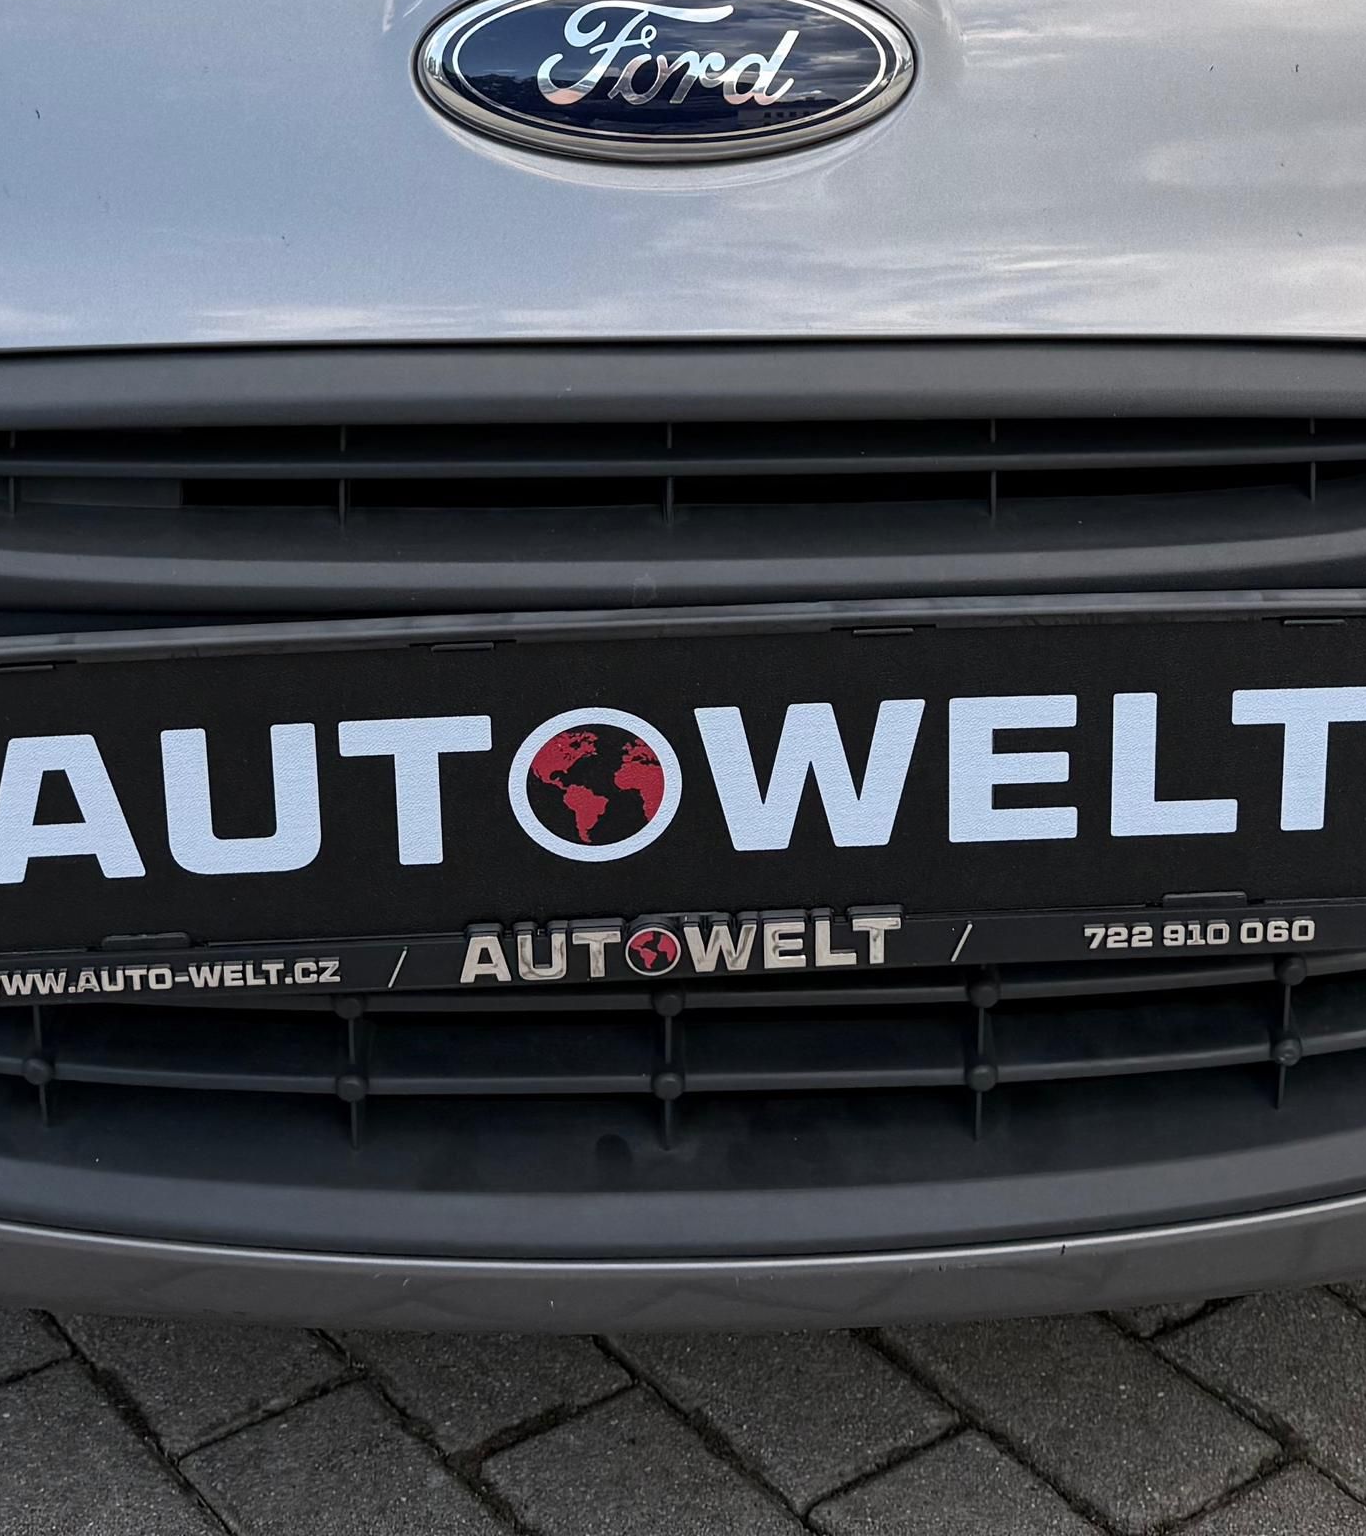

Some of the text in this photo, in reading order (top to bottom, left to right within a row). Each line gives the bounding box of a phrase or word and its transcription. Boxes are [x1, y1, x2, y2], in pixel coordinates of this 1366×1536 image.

[537, 0, 799, 106] Ford
[460, 914, 902, 983] AUTOWELT
[1084, 925, 1153, 949] 722
[1163, 923, 1229, 946] 910
[1240, 919, 1315, 944] 060
